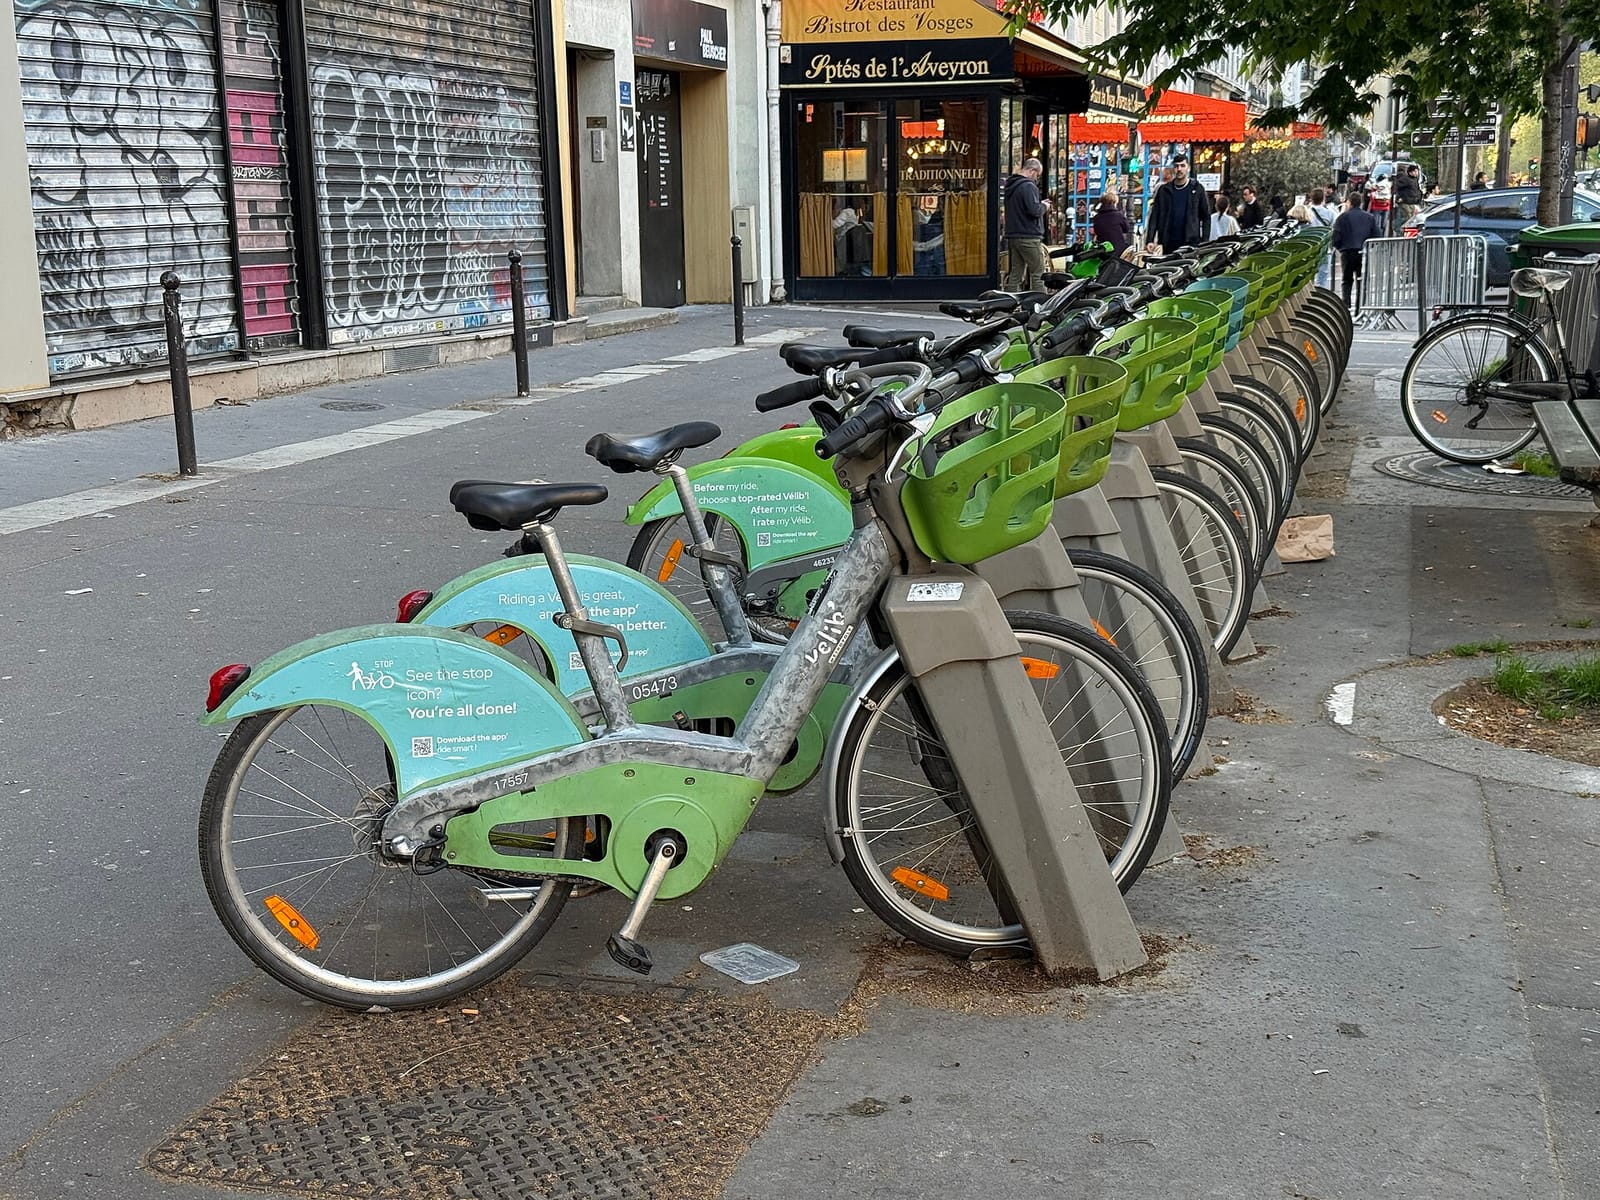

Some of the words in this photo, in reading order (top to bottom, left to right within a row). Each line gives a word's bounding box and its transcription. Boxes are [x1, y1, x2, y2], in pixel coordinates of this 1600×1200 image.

[804, 15, 871, 34] Bistrot
[878, 16, 905, 32] des
[911, 11, 974, 33] Vosges
[865, 57, 887, 77] de
[901, 168, 985, 181] TRADITIONNELLE
[694, 483, 724, 492] Before
[726, 484, 739, 492] my
[698, 496, 729, 504] choose
[738, 493, 782, 504] top-rated
[751, 504, 774, 514] After
[775, 506, 789, 514] my
[757, 517, 775, 526] rate
[777, 519, 789, 527] my
[813, 556, 835, 567] 46233
[499, 593, 536, 606] Riding
[581, 590, 590, 601] is
[592, 590, 625, 601] great,
[590, 606, 611, 616] the
[626, 620, 667, 631] better.
[374, 660, 394, 668] STOP
[406, 670, 433, 682] See
[436, 669, 460, 680] the
[463, 668, 493, 681] stop
[632, 676, 678, 699] 05473
[407, 688, 442, 701] icon?
[407, 706, 453, 719] You're
[456, 704, 473, 717] all
[476, 702, 517, 715] done!
[437, 735, 476, 744] Download
[437, 745, 452, 753] ride
[494, 772, 529, 790] 17557
